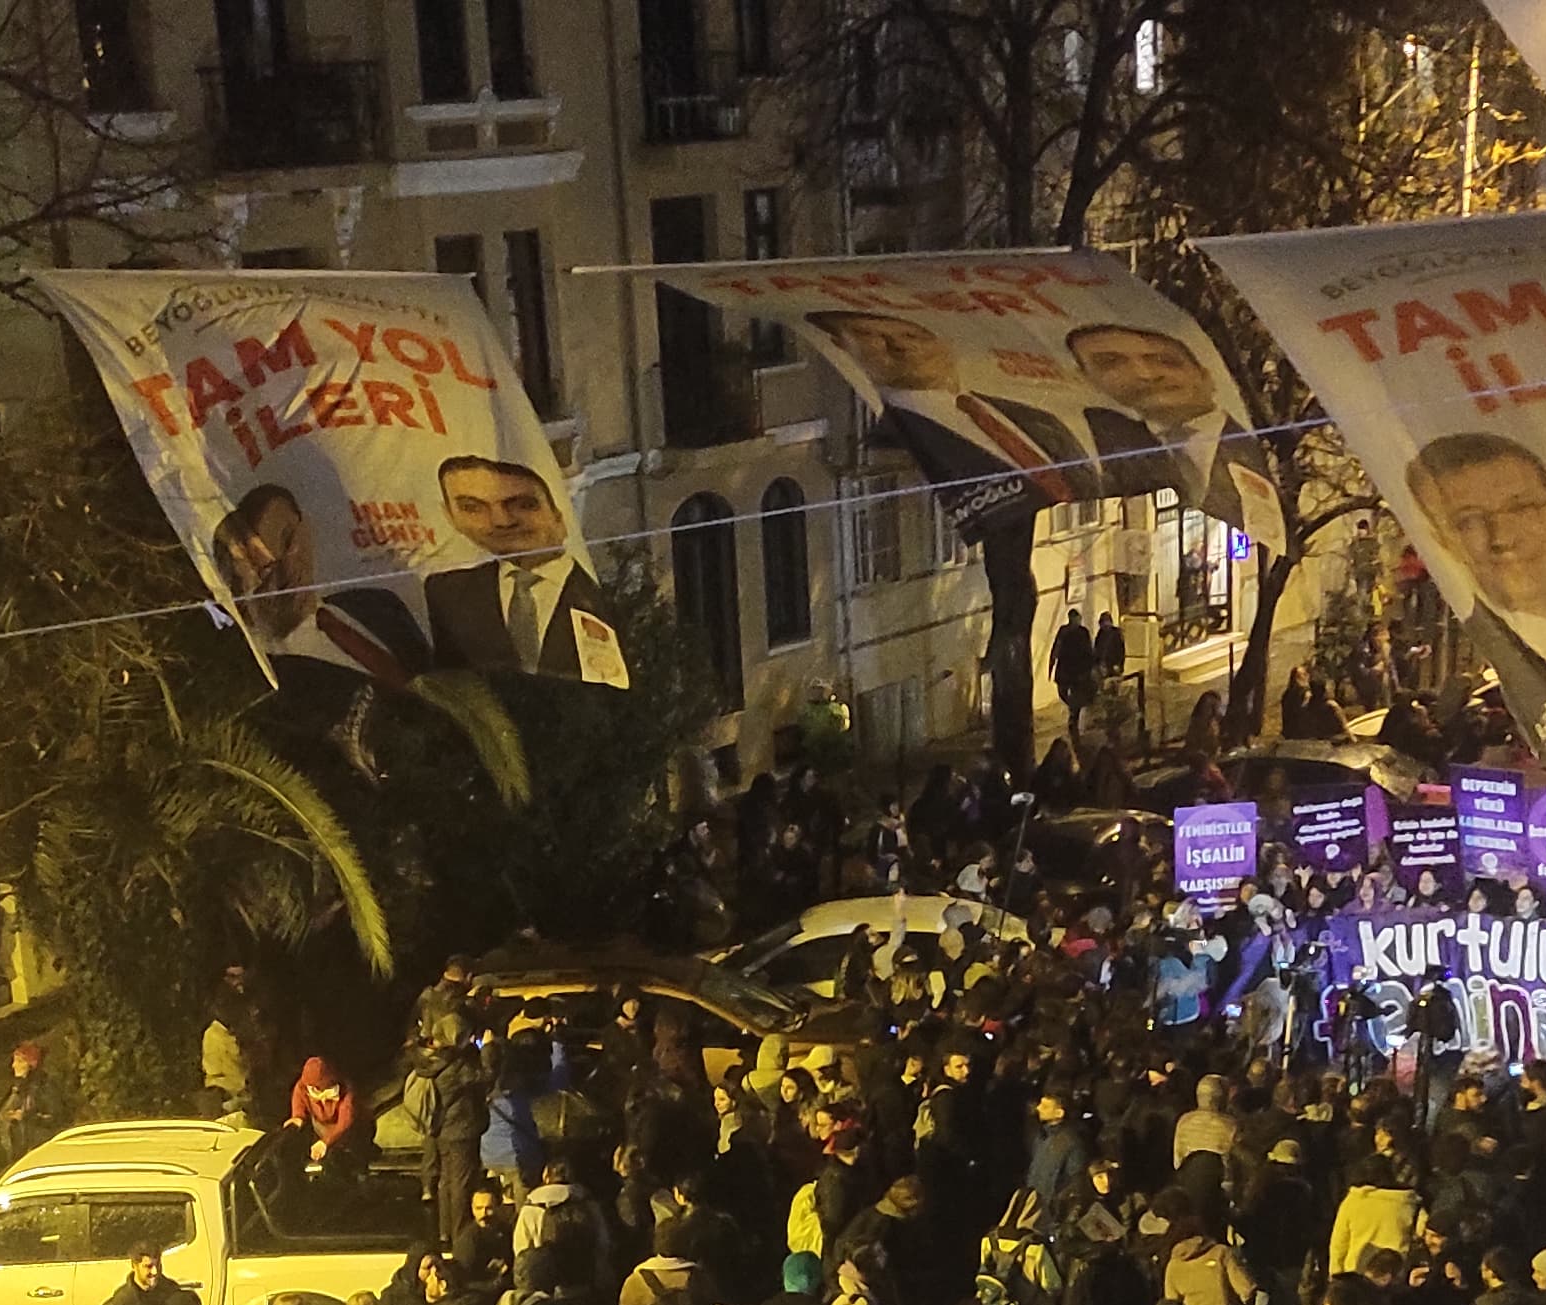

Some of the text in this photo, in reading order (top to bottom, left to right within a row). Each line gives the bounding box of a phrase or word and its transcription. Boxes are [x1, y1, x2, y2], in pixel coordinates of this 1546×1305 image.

[132, 318, 497, 436] TAM YOL
[225, 373, 448, 470] İLERİ
